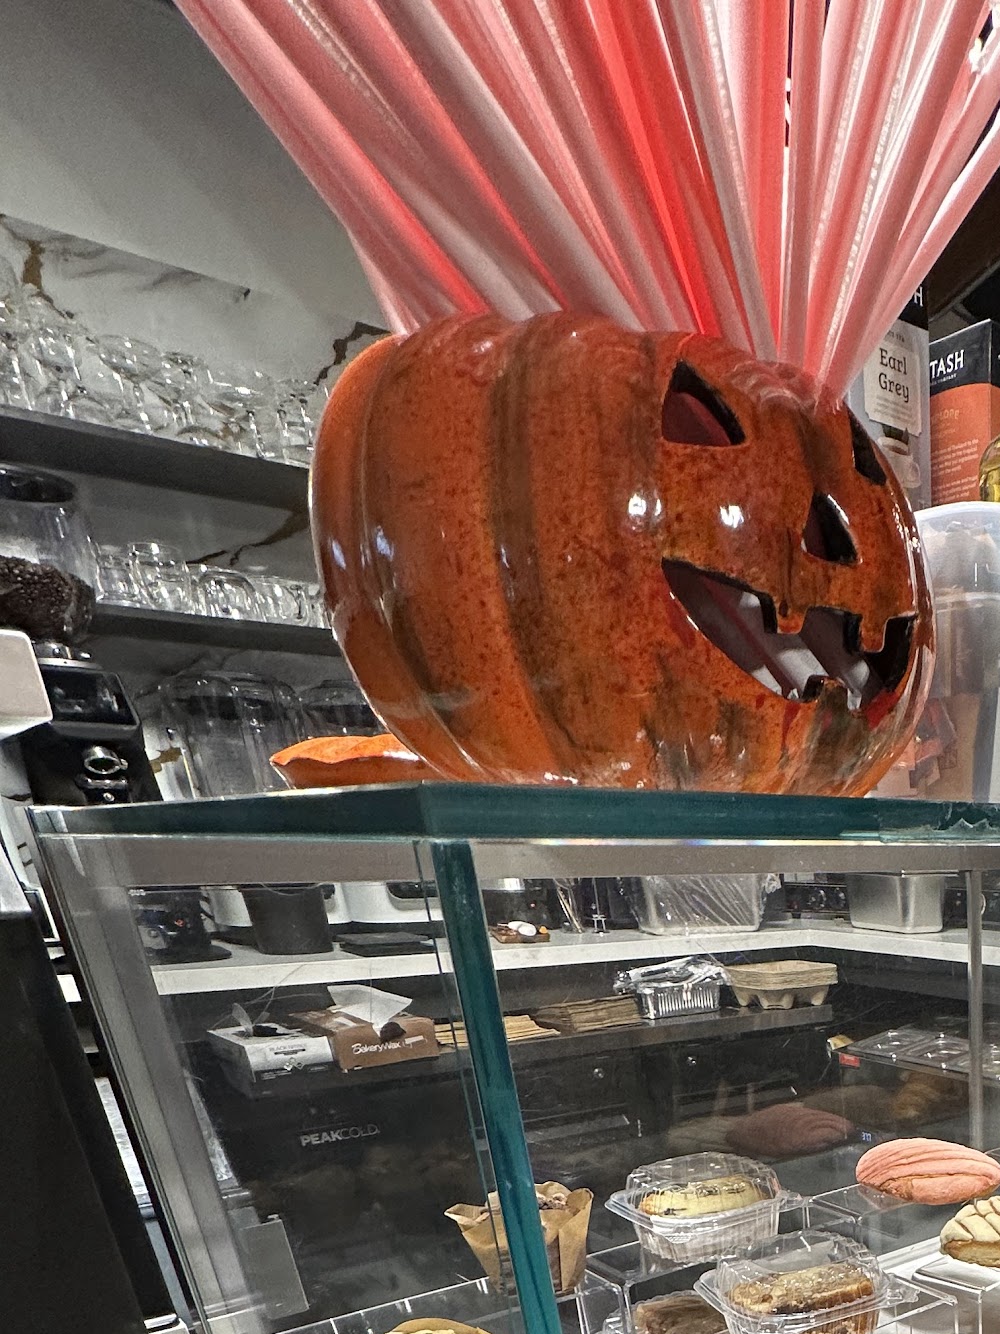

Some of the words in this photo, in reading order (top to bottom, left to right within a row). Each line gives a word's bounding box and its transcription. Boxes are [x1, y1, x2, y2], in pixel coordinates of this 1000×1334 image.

[879, 347, 907, 375] Earl
[929, 349, 965, 379] TASH
[878, 372, 909, 403] Grey
[300, 1124, 379, 1147] PEAKCOLD
